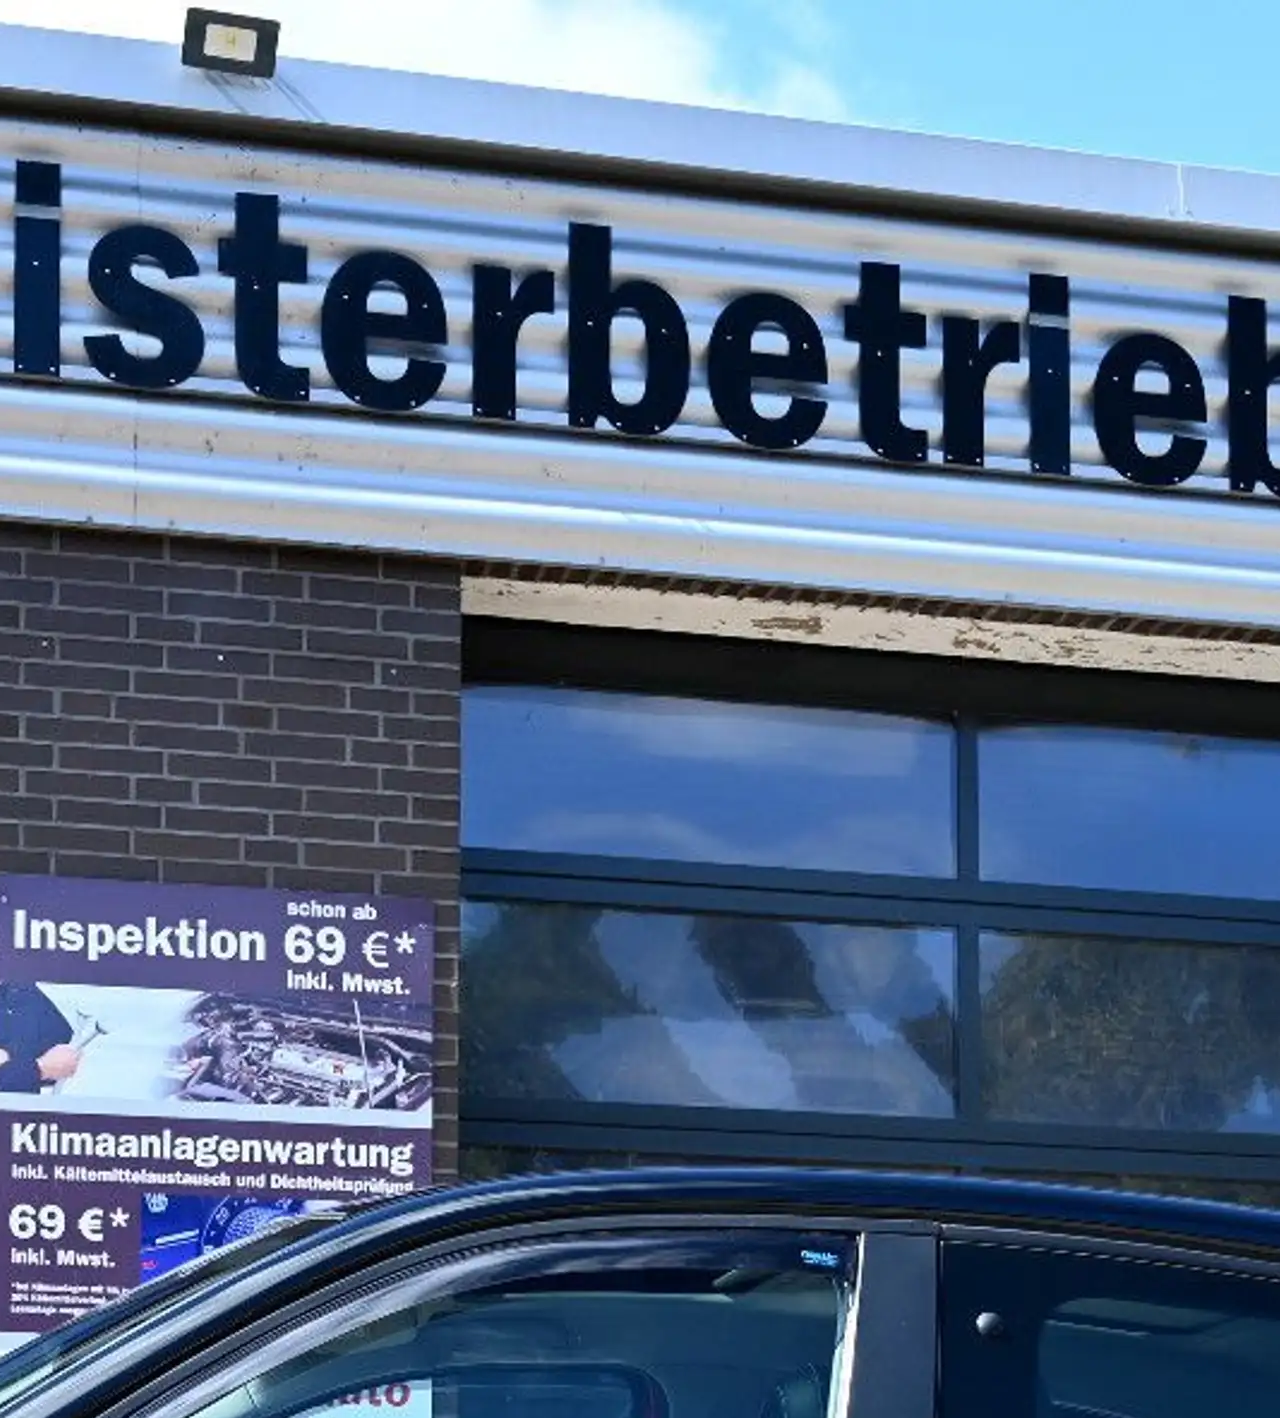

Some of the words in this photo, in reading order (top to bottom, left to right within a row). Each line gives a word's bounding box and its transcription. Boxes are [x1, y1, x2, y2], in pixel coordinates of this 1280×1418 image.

[287, 899, 346, 918] schon
[352, 902, 377, 920] ab
[13, 908, 267, 961] Inspektion
[284, 923, 346, 966] 69
[341, 971, 411, 995] Mwst.
[11, 1121, 415, 1177] Klimaanlagenwartung
[236, 1174, 267, 1189] und
[8, 1203, 66, 1241] 69
[56, 1249, 117, 1269] Mwst.
